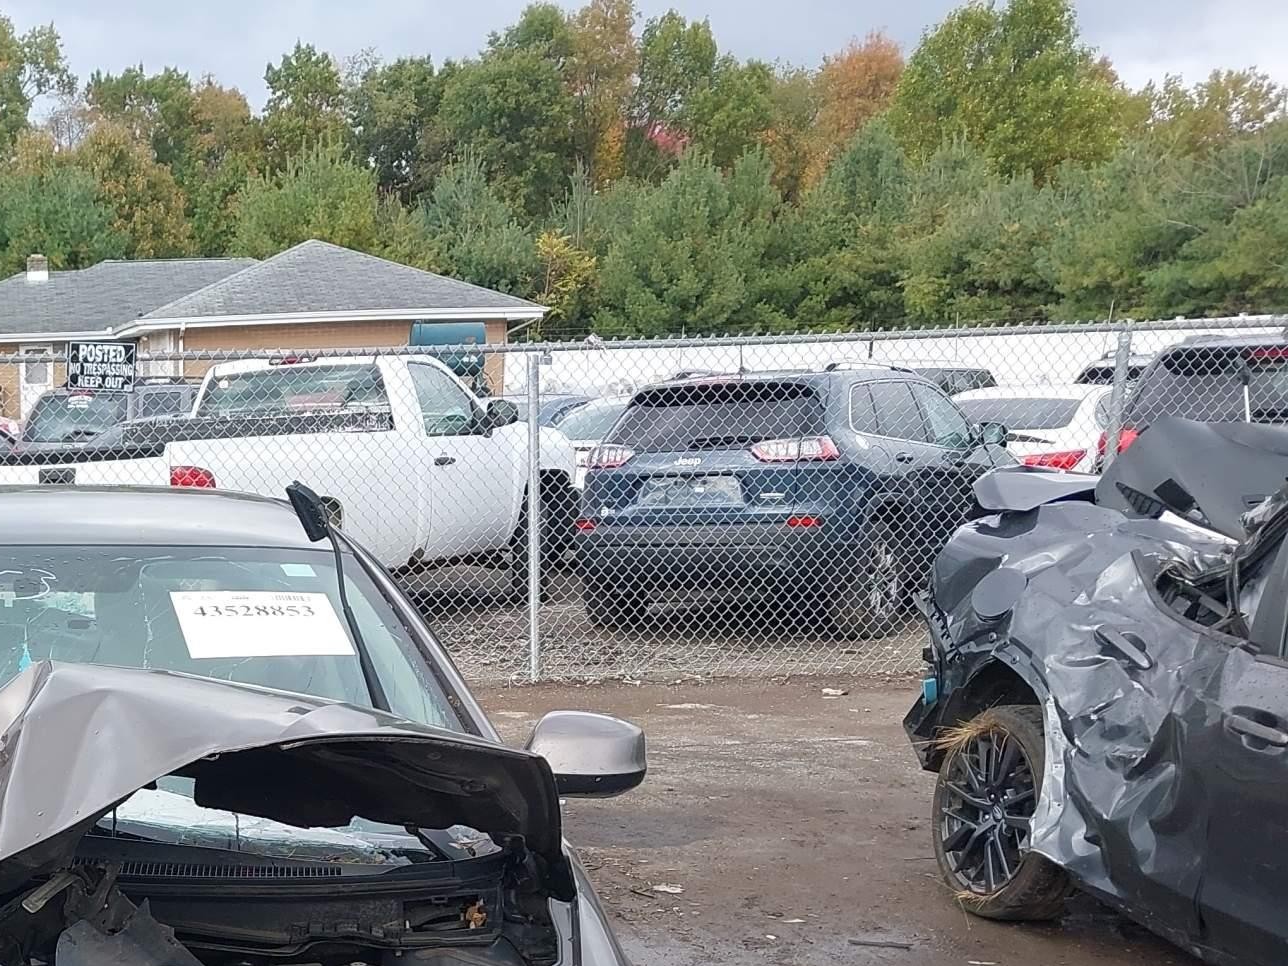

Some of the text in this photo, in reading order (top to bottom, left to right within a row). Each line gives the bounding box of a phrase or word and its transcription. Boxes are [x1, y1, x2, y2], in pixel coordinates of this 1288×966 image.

[78, 344, 125, 362] POSTED
[70, 362, 133, 376] NO TRESPASSING
[77, 376, 124, 389] KEEP OUT
[673, 456, 702, 467] Jeep
[193, 605, 316, 617] 43528853
